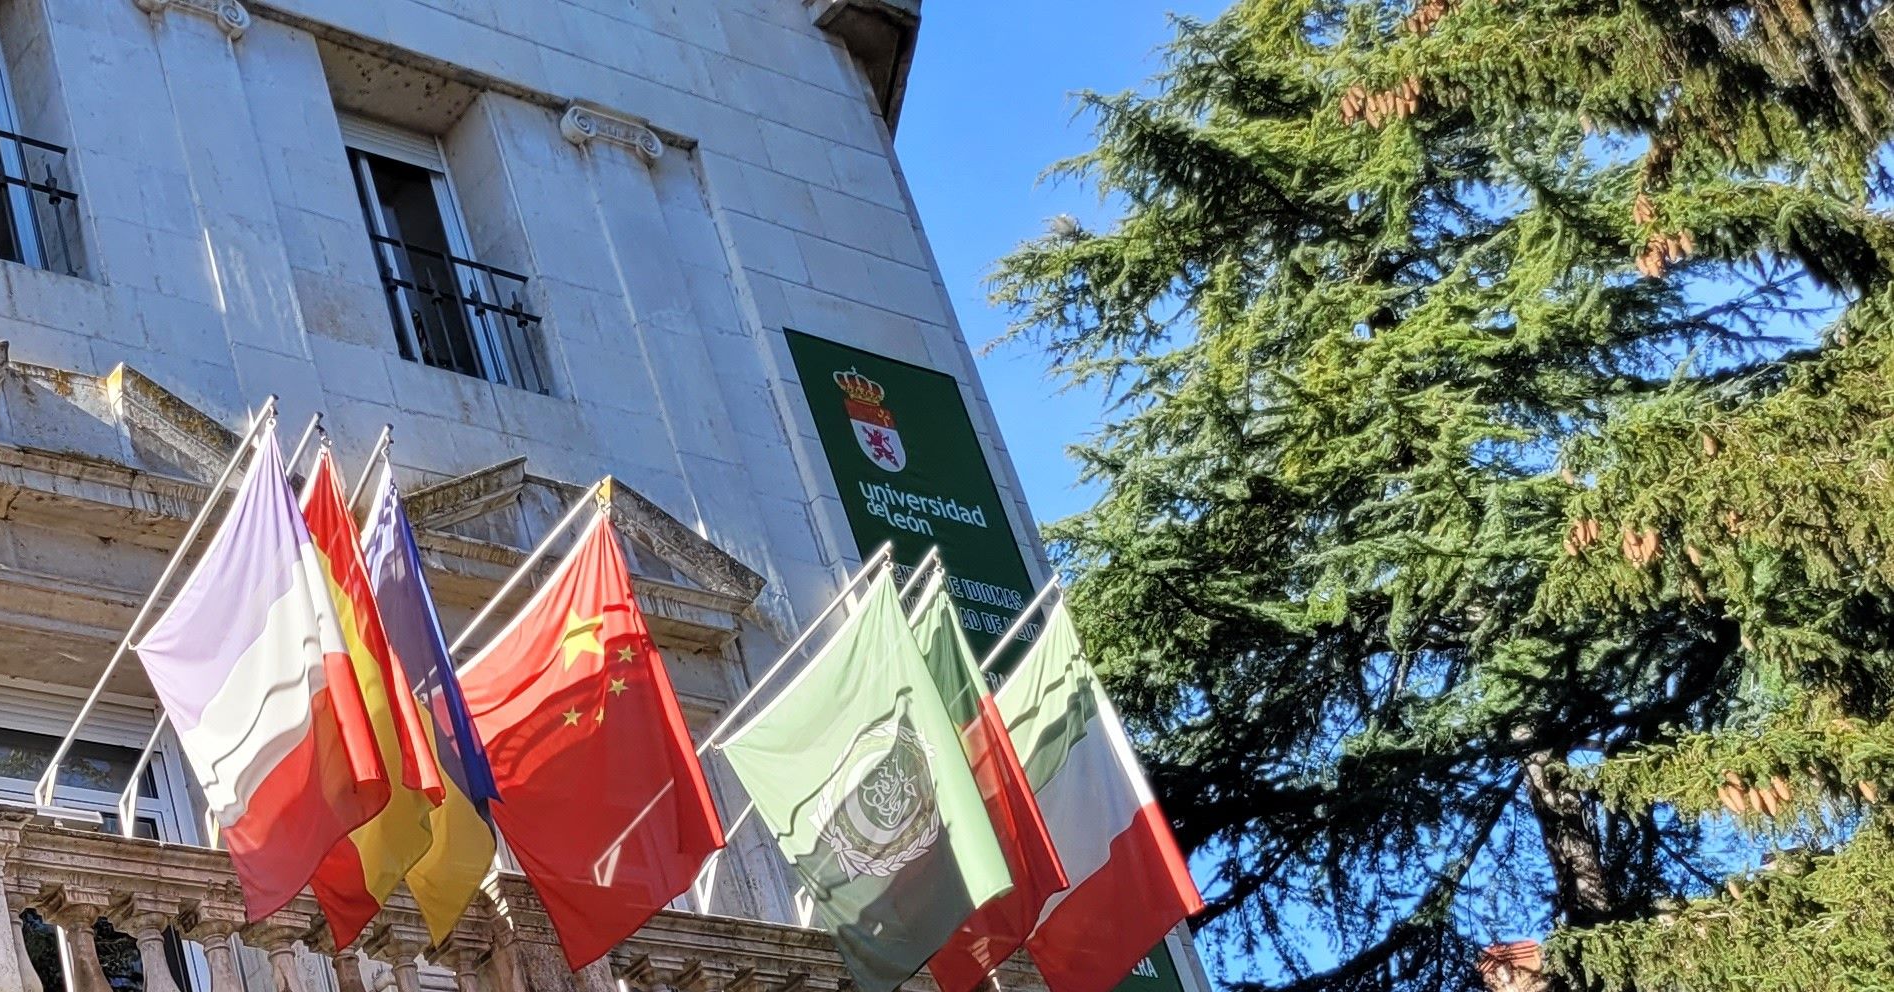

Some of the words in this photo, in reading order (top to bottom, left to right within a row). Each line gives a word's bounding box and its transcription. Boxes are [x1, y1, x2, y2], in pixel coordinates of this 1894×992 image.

[858, 480, 988, 529] universidad
[882, 500, 934, 536] león
[961, 578, 1024, 612] IDIOMAS
[980, 611, 1005, 636] DE
